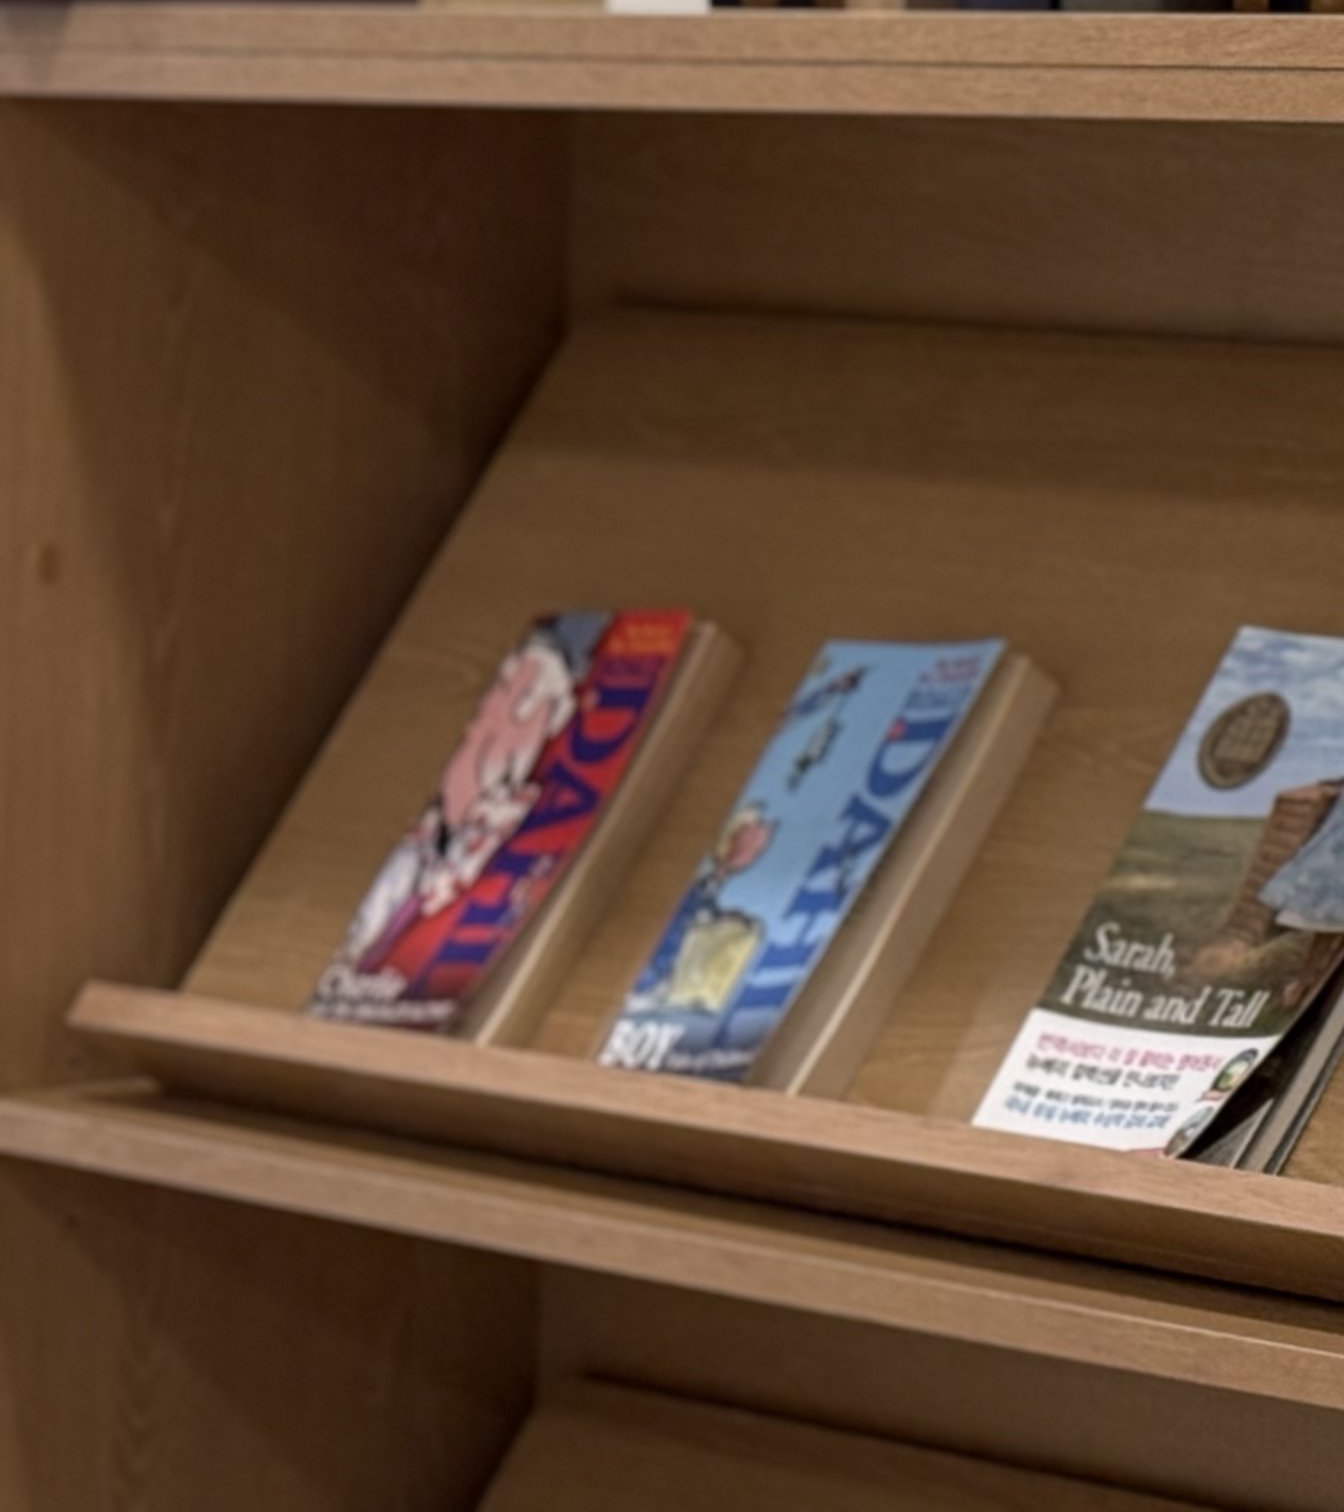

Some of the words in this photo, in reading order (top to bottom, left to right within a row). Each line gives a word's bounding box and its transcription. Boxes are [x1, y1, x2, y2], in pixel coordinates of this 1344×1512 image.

[1083, 921, 1176, 980] Sarah,
[1060, 964, 1143, 1018] Plain
[1143, 985, 1211, 1025] and
[1207, 989, 1270, 1028] Tall
